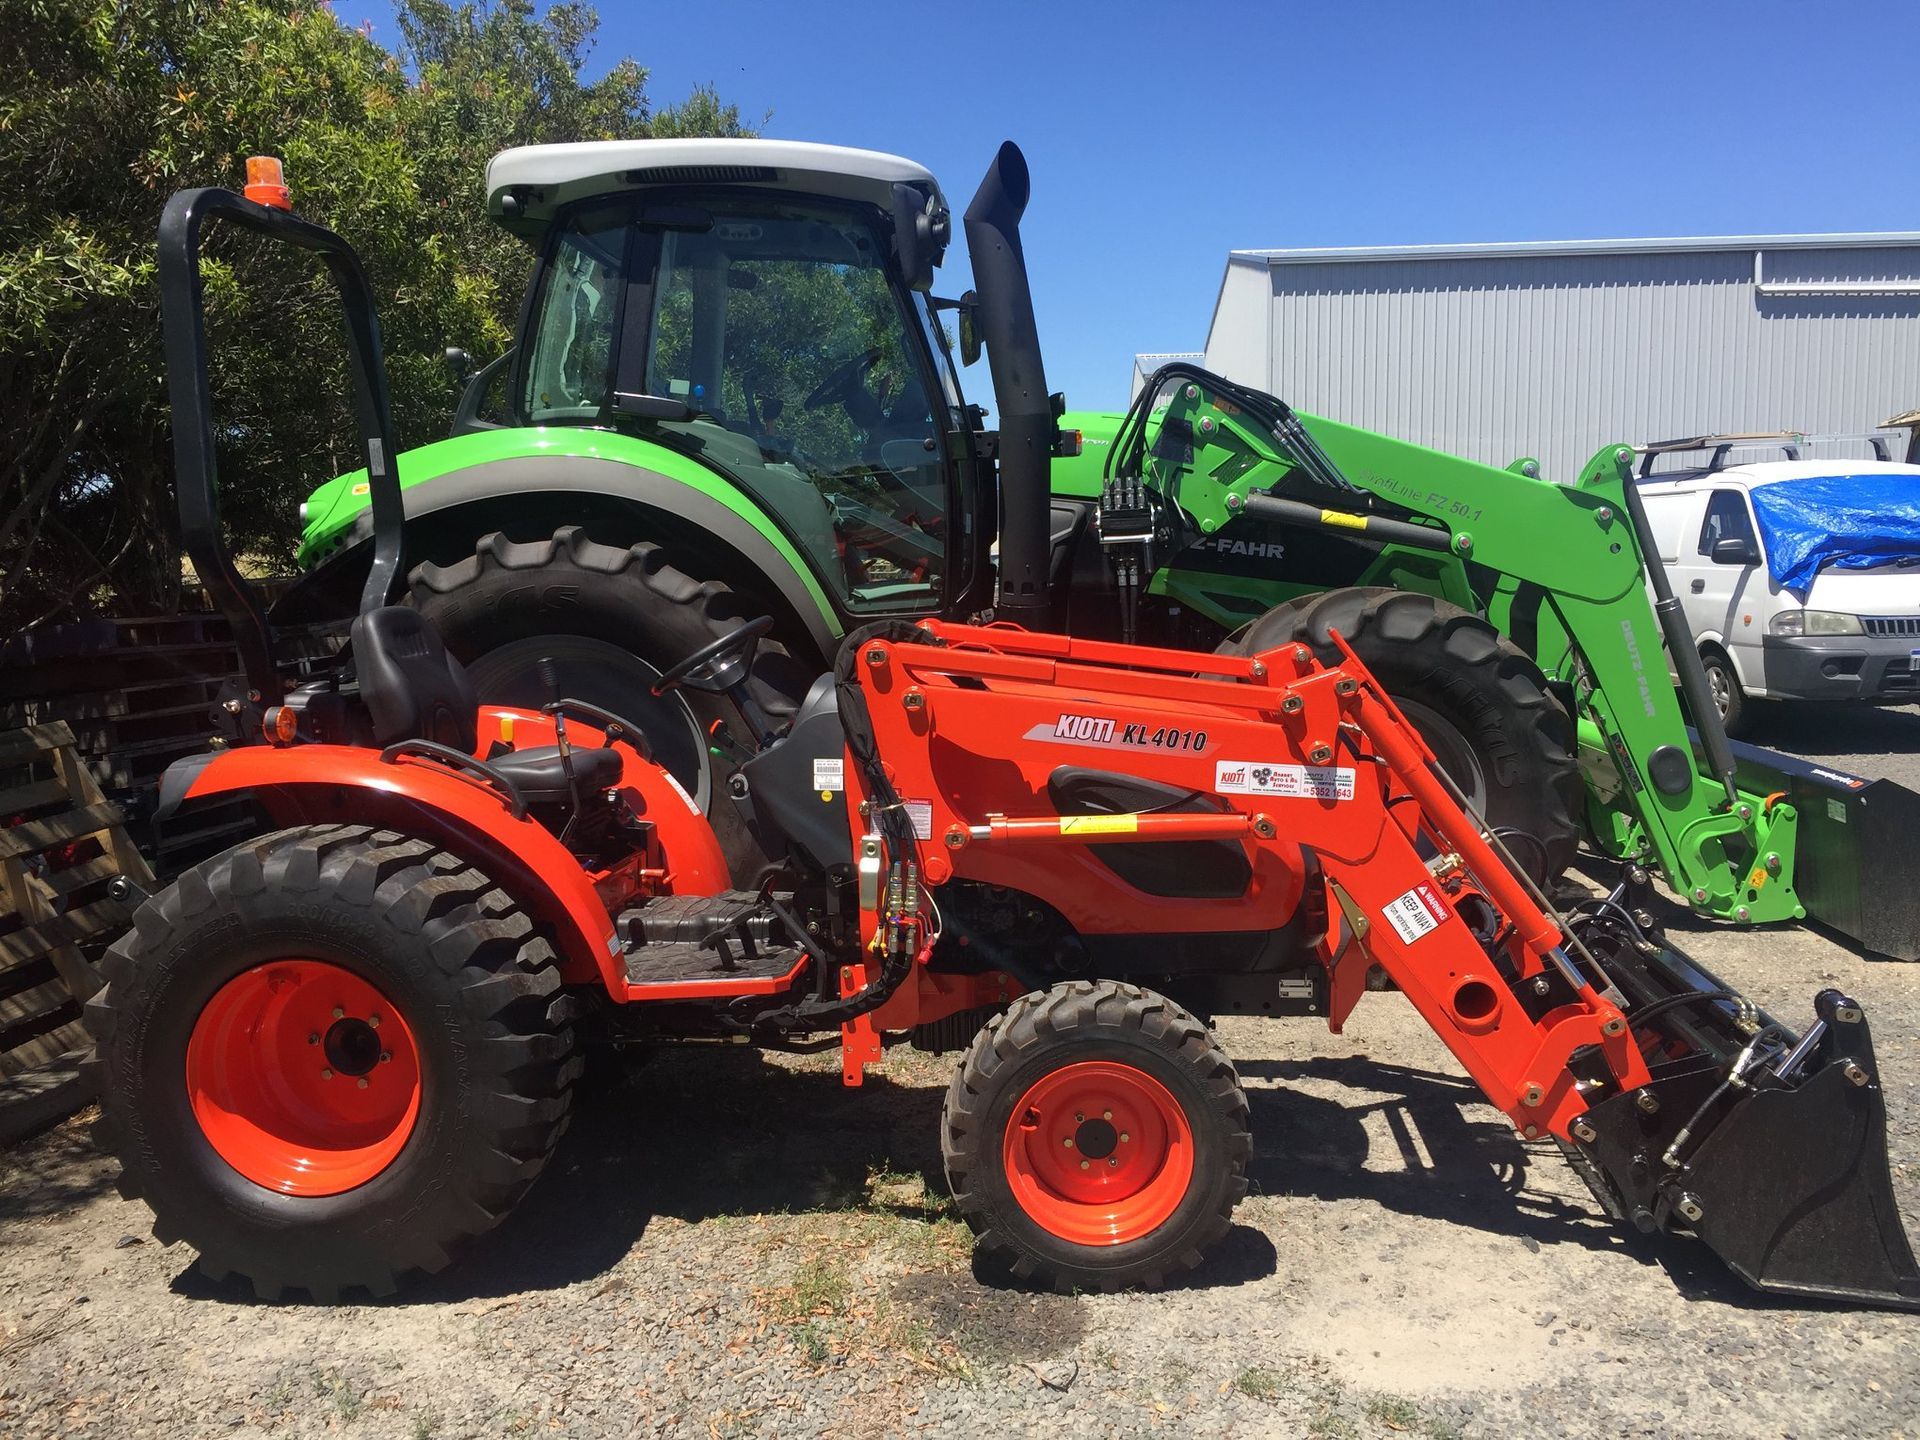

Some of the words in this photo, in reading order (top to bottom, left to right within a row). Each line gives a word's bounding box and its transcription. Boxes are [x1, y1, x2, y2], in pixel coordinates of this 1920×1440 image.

[1425, 492, 1449, 510] FZ
[1450, 501, 1483, 521] 50.1
[1621, 619, 1656, 718] DEUTZ-FAHR
[1054, 713, 1117, 743] KIOTI
[1220, 771, 1246, 783] KIOTI
[1400, 893, 1419, 912] KEEP
[1411, 911, 1433, 931] AWAY
[1425, 891, 1448, 921] WARNING
